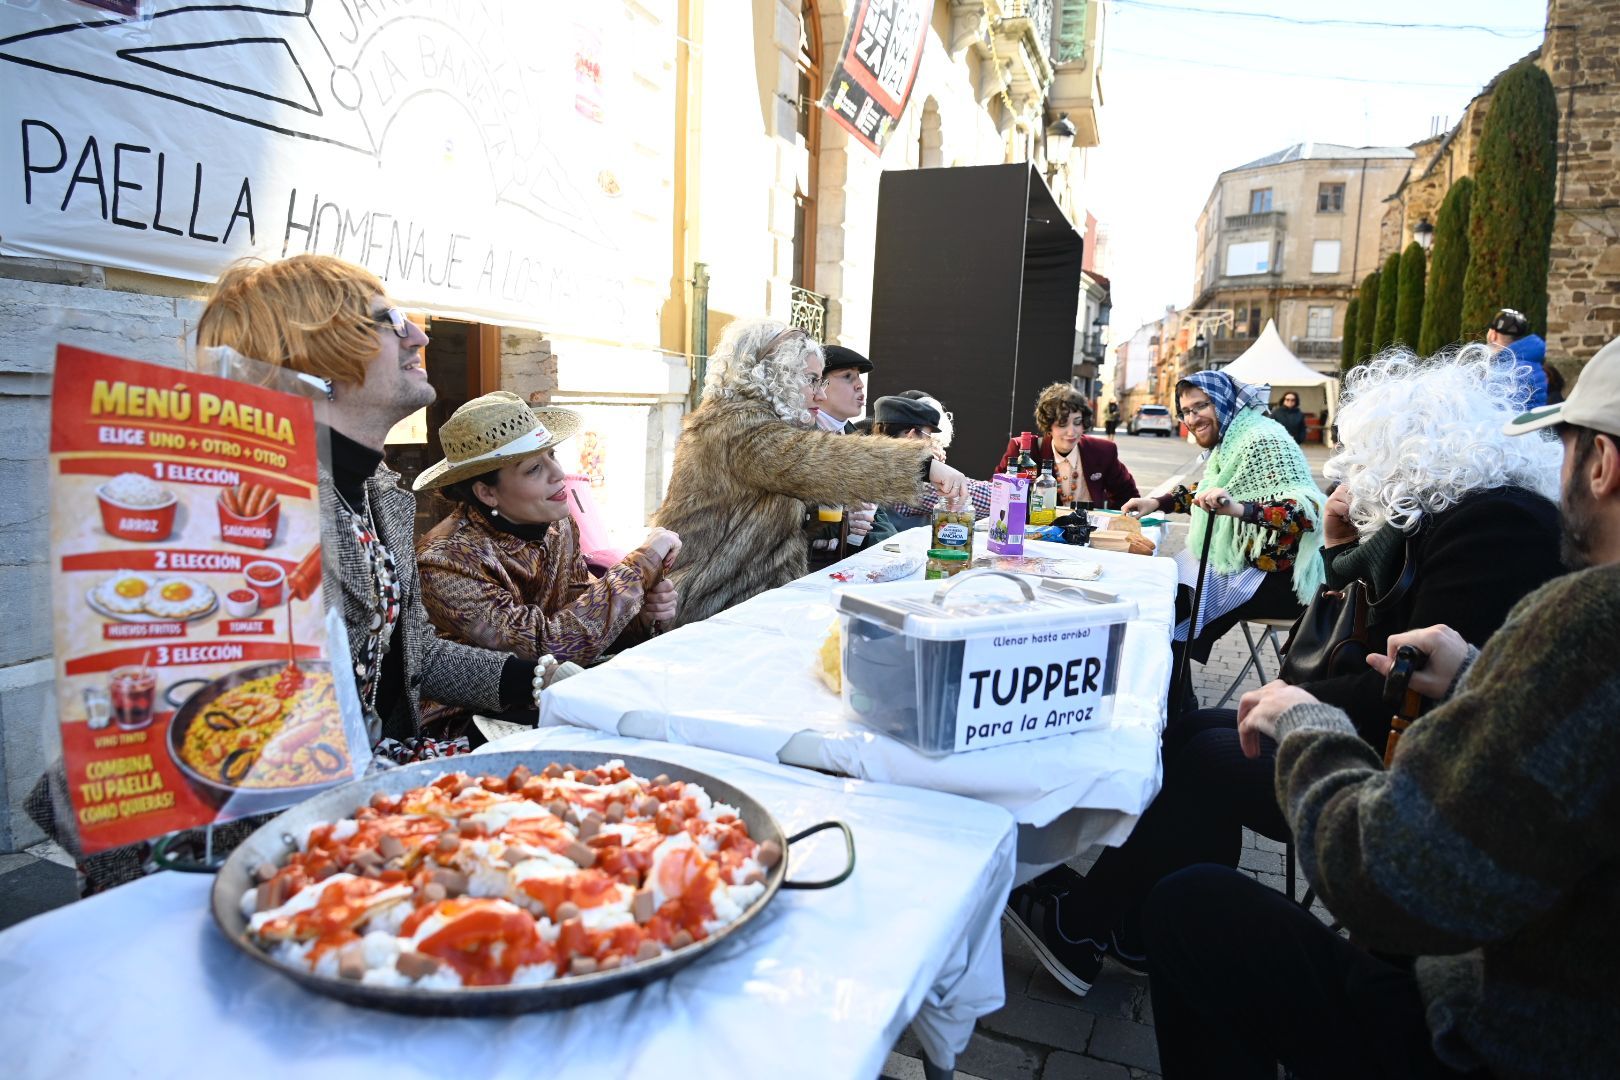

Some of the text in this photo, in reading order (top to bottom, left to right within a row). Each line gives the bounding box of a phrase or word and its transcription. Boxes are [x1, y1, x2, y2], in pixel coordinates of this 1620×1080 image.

[21, 119, 255, 245] PAELLA
[283, 188, 471, 289] HOMENAJE
[90, 380, 296, 446] MENÚ PAELLA
[98, 426, 145, 445] ELIGE
[149, 431, 185, 449] UNO
[201, 438, 241, 457] OTRO
[253, 448, 287, 468] OTRO
[153, 462, 240, 485] 1 ELECCIÓN
[119, 517, 159, 533] ARROZ
[154, 550, 241, 570] 2 ELECCIÓN
[230, 621, 263, 633] TOMATE
[1031, 633, 1058, 643] hasta
[1061, 627, 1091, 640] arriba)
[157, 642, 243, 665] 3 ELECCIÓN
[969, 656, 1101, 709] TUPPER
[966, 706, 1093, 746] para la Arroz
[86, 754, 153, 779] COMBINA
[79, 771, 163, 803] TU PAELLA
[79, 802, 119, 824] COMO
